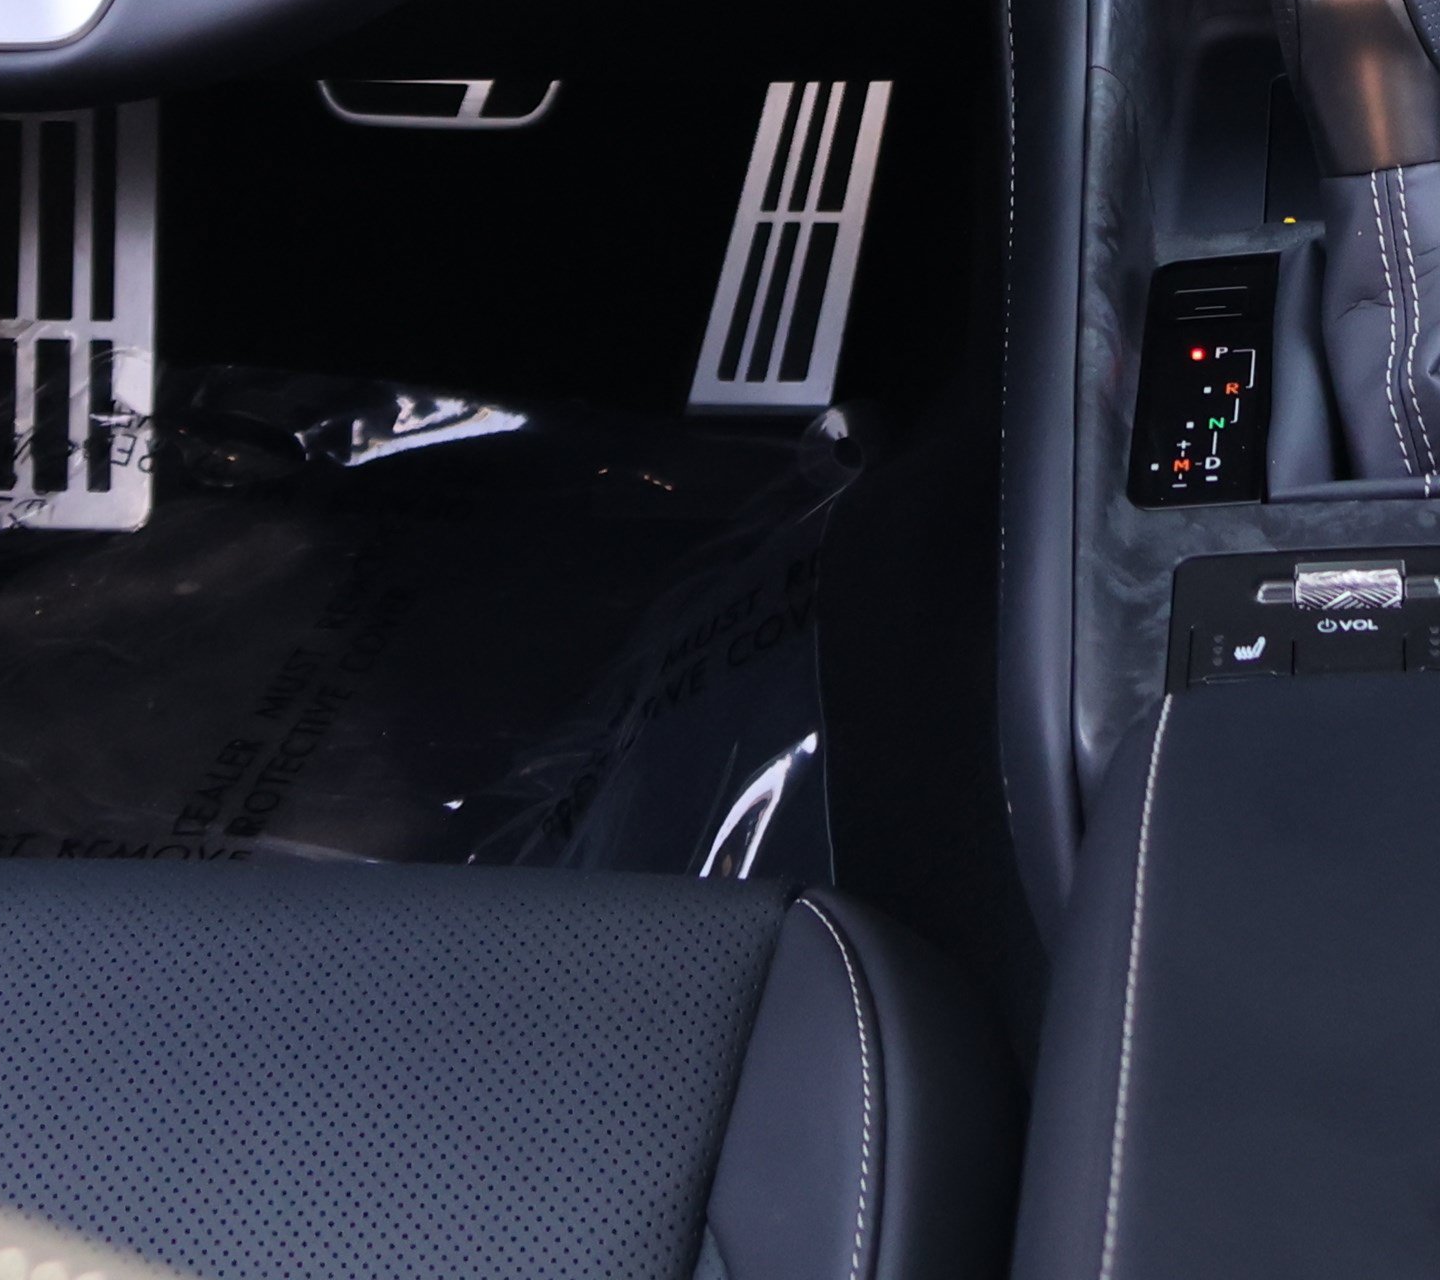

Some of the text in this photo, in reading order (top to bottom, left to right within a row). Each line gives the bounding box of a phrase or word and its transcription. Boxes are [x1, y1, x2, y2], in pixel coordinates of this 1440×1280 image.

[1215, 346, 1229, 359] P
[1225, 382, 1240, 395] R
[1208, 416, 1225, 430] N
[1173, 456, 1221, 473] M D
[1340, 619, 1379, 632] VOL
